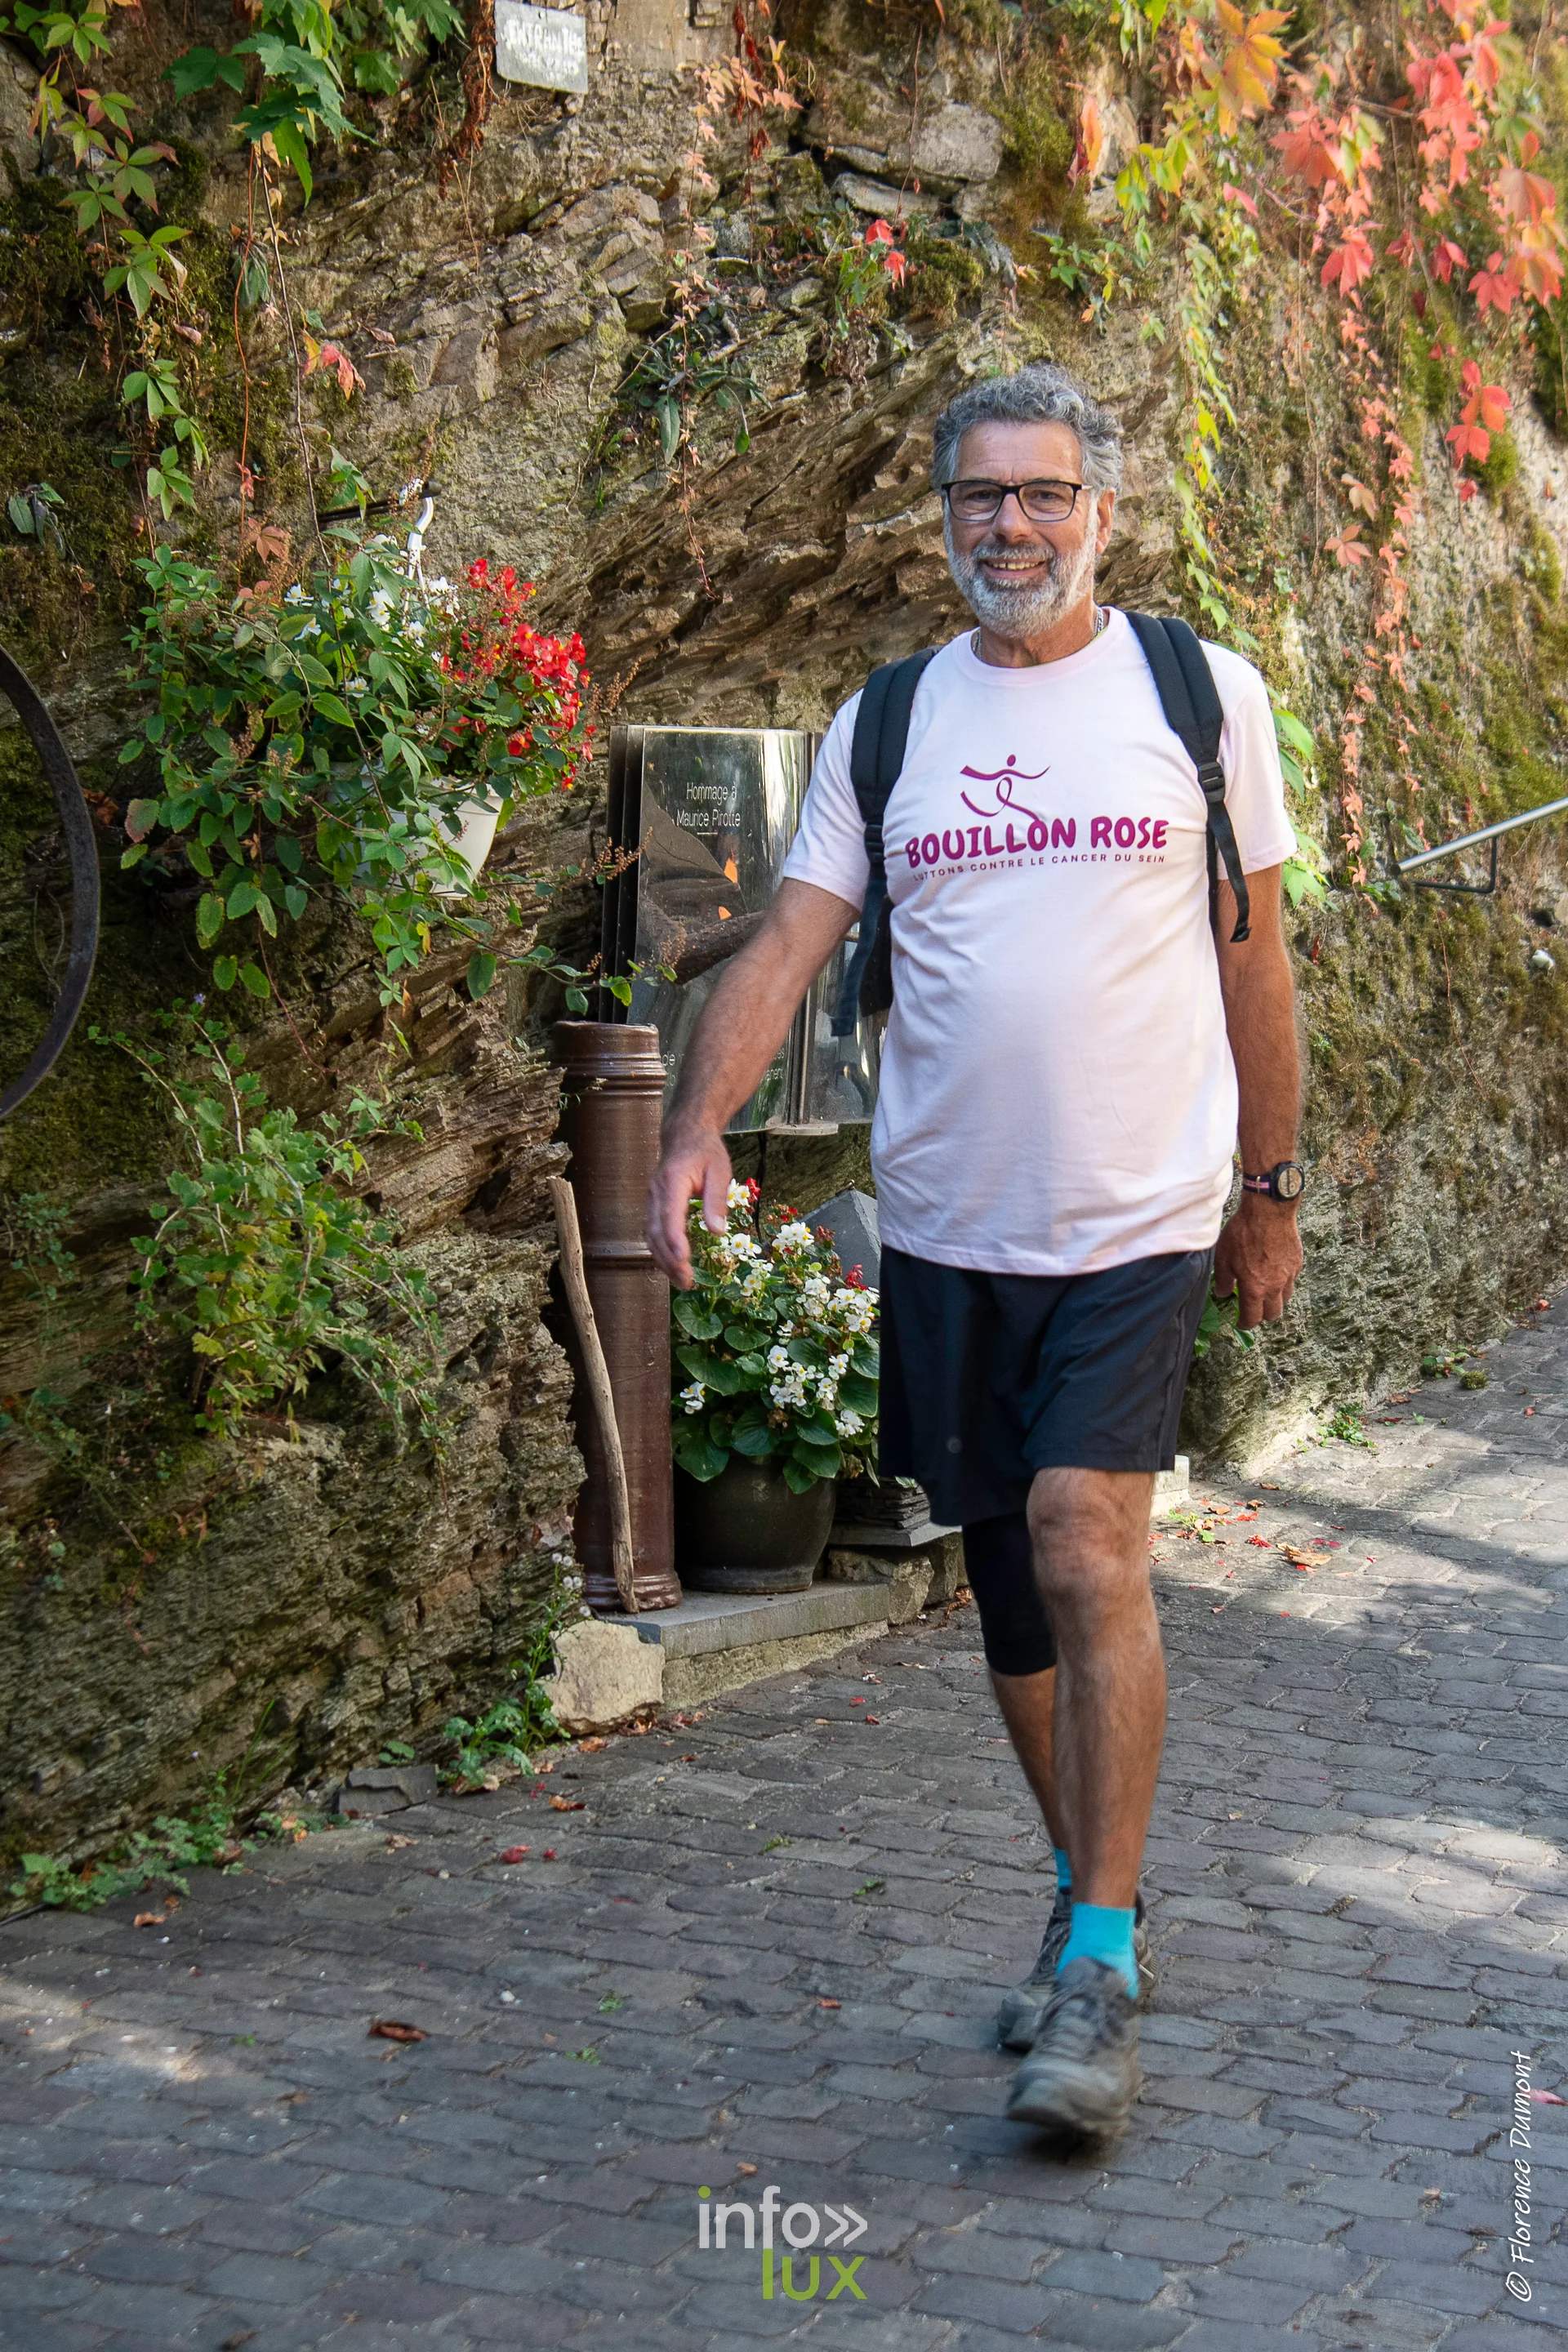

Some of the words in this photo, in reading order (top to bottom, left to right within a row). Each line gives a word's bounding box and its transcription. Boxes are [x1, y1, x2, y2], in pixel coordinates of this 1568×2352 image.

[686, 782, 728, 805] Hommage
[731, 781, 737, 800] à
[676, 808, 710, 826] Maurice
[712, 808, 741, 827] Pirotte
[905, 818, 1076, 869] BOUILLON
[1091, 817, 1169, 849] ROSE
[913, 865, 964, 881] LUTTONS
[970, 858, 1023, 871] CONTRE
[1031, 857, 1045, 866] LE
[1052, 853, 1107, 864] CANCER
[1115, 853, 1132, 862] DU
[1138, 854, 1165, 863] SEIN
